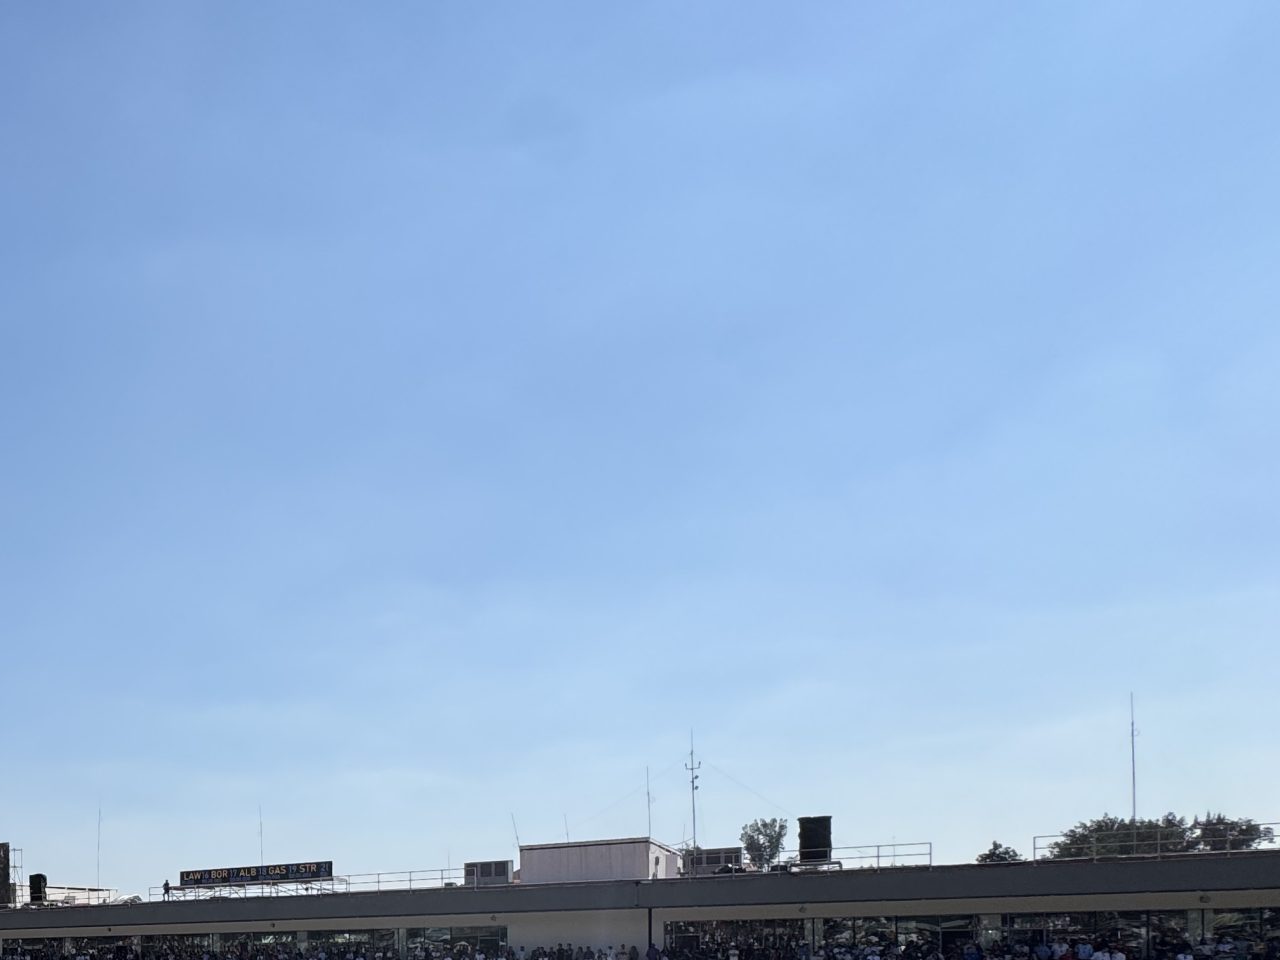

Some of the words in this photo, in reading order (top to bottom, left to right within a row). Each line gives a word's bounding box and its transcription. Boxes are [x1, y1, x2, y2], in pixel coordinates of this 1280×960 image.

[184, 872, 201, 880] LAW
[211, 870, 228, 878] BOR
[239, 868, 256, 877] ALB
[269, 866, 286, 874] GAS
[299, 864, 317, 872] STR
